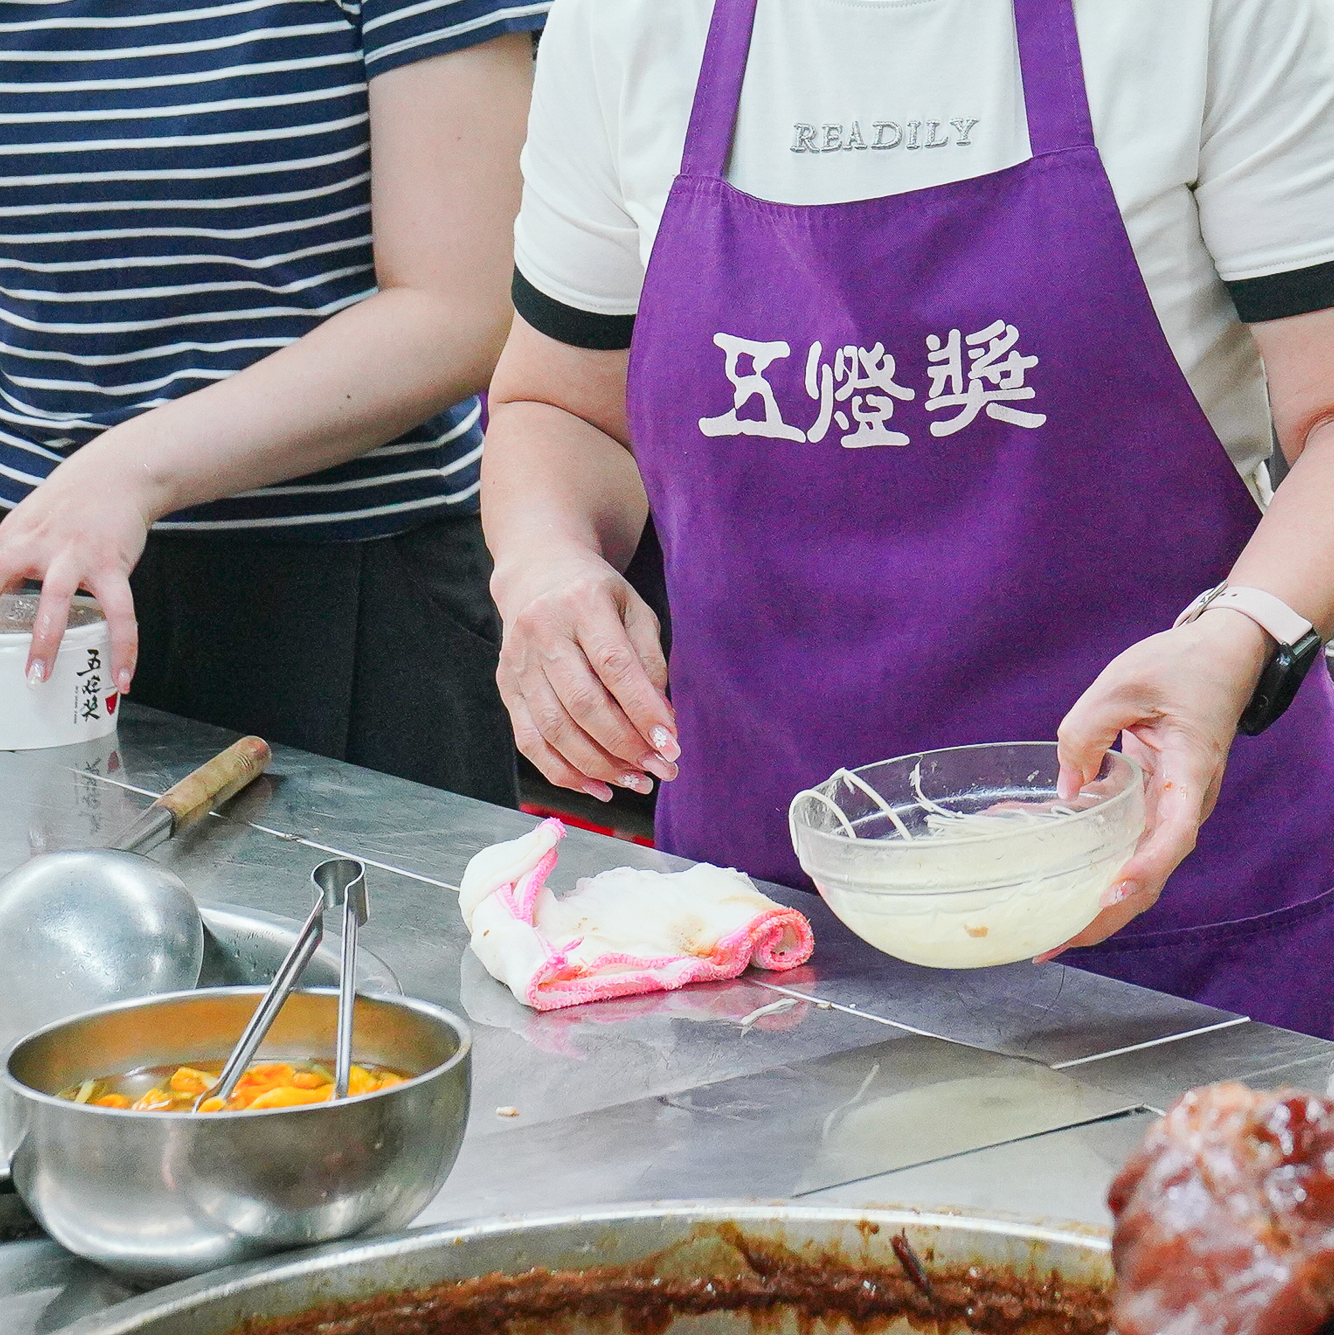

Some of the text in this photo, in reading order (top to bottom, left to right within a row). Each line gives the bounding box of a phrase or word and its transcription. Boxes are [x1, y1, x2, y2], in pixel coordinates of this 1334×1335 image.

[790, 118, 980, 154] READILY
[697, 319, 1047, 449] 五燈獎
